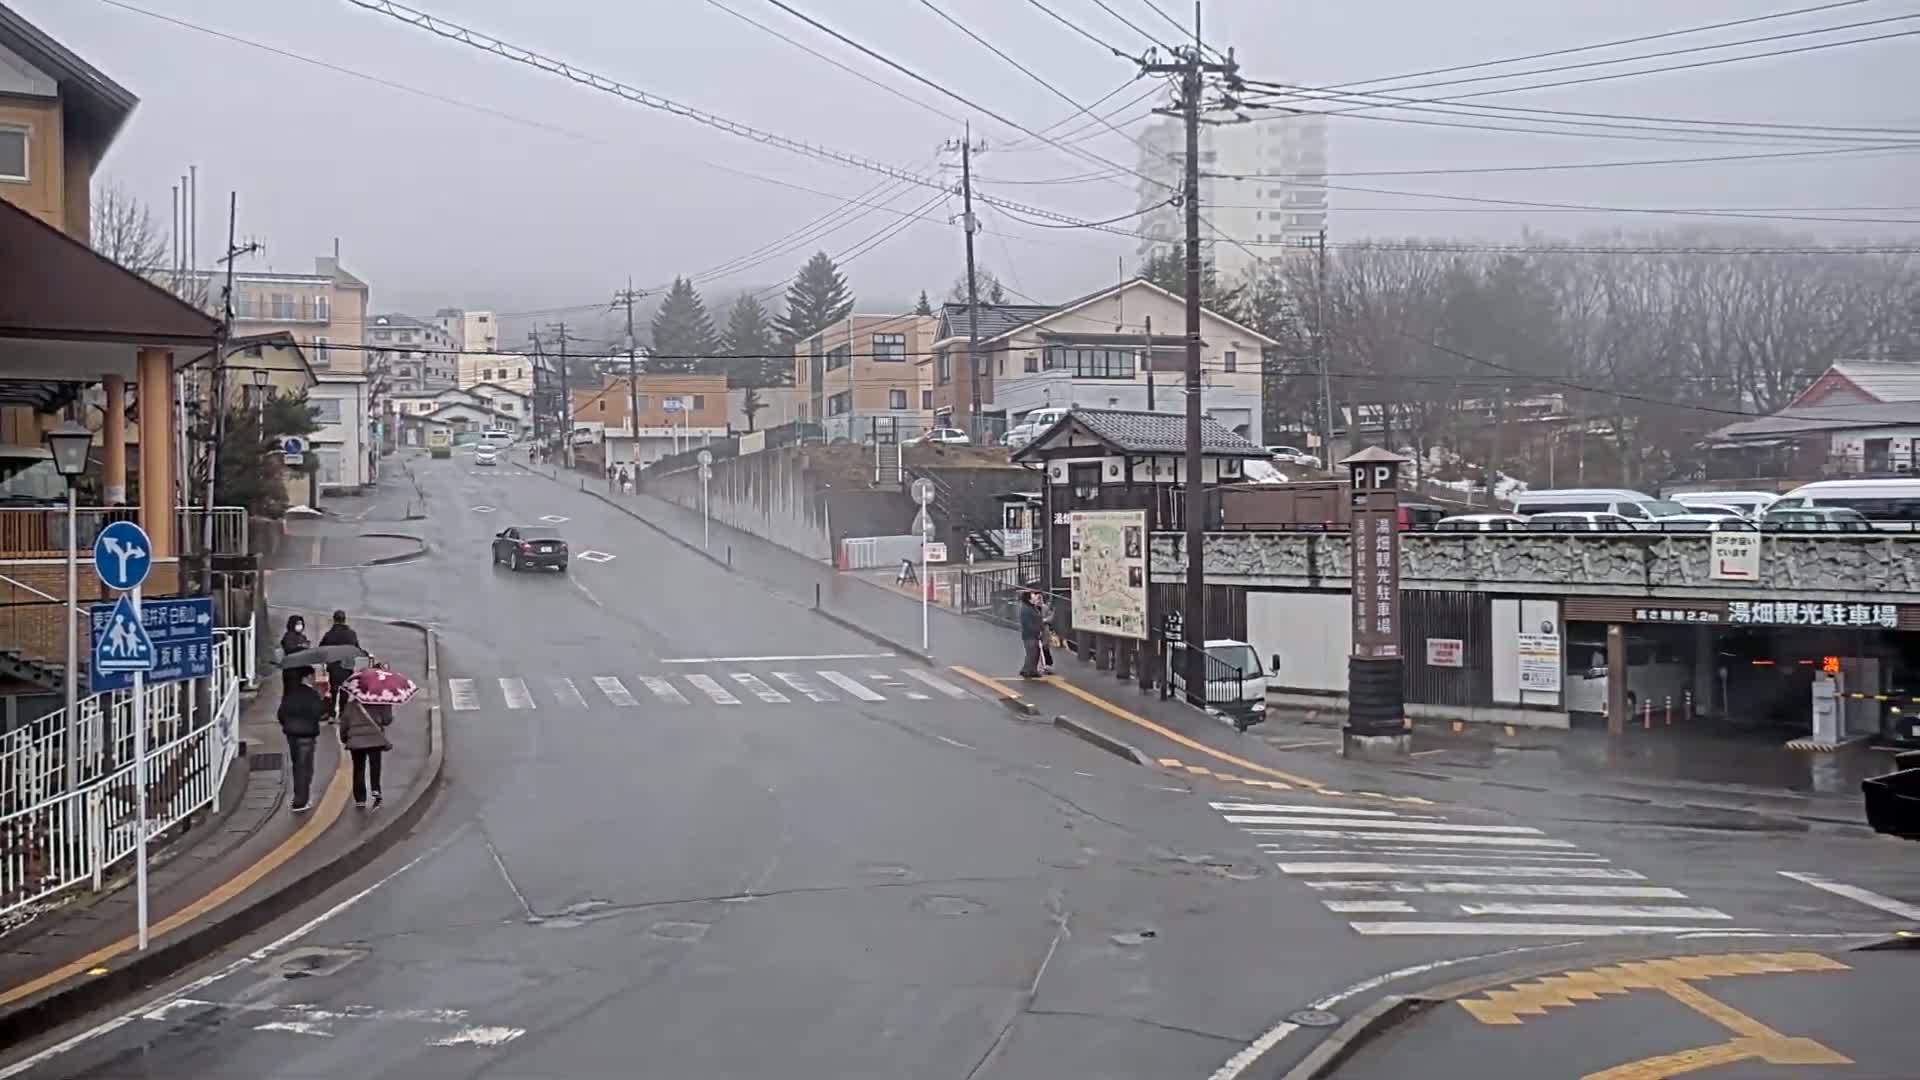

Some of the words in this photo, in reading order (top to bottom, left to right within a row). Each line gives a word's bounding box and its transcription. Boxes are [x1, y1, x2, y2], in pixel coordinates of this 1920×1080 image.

[1375, 467, 1390, 489] P
[1376, 518, 1391, 634] 湯畑観光駐車場
[1727, 601, 1899, 628] 湯畑観光駐車場
